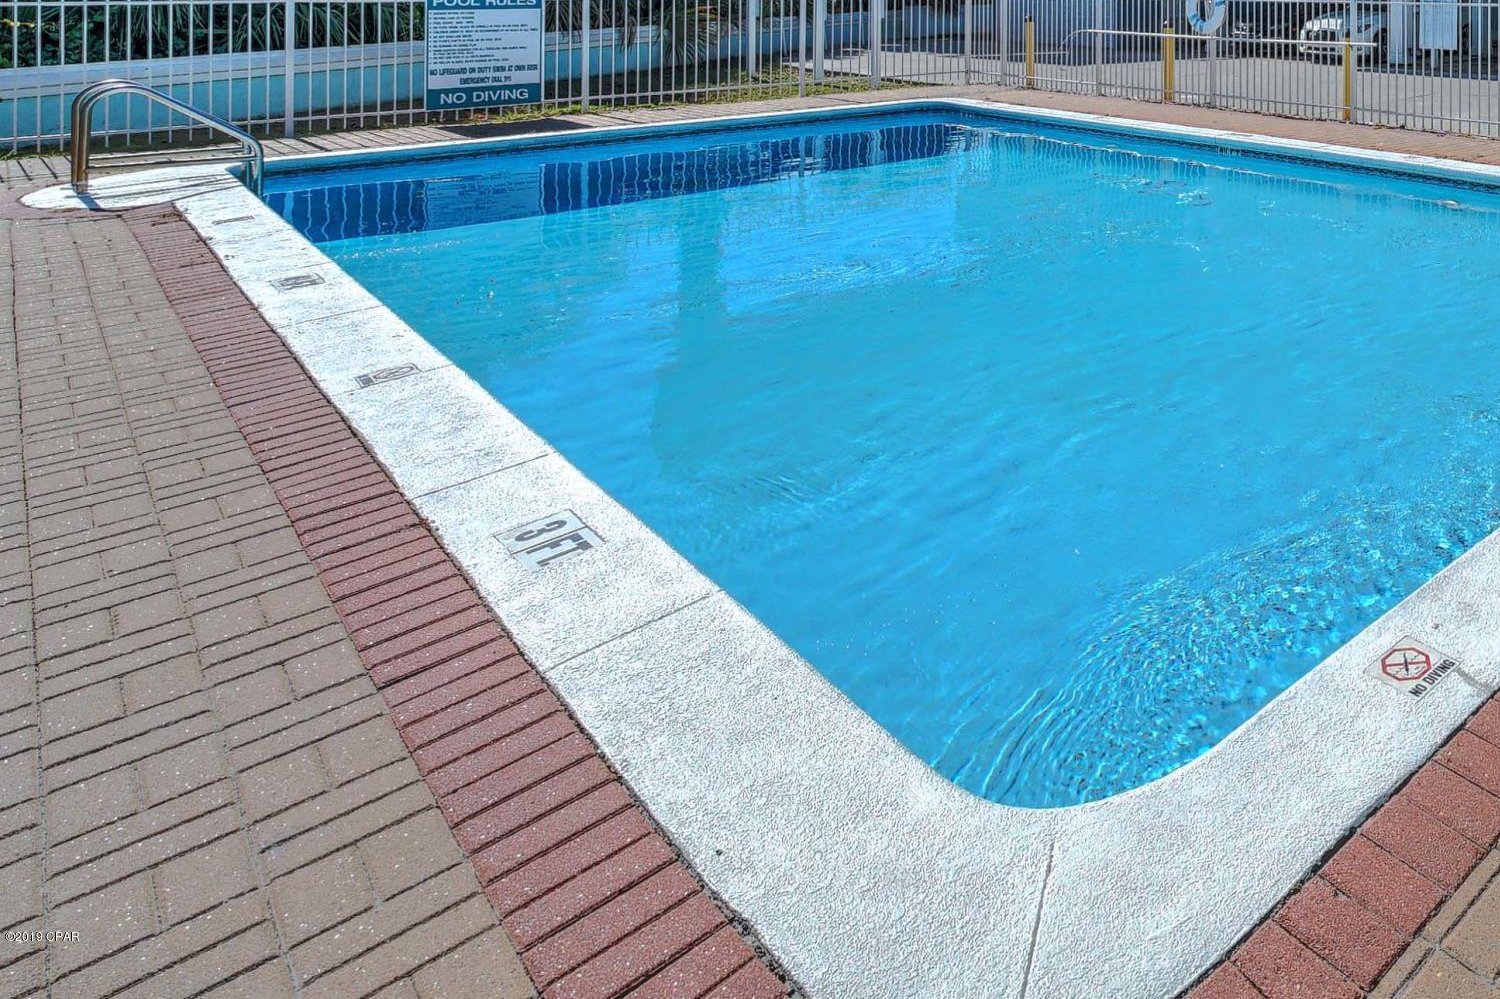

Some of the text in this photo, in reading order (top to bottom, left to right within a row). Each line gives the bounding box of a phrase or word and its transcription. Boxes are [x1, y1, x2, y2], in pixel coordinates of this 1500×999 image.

[477, 66, 491, 74] DUTY
[459, 77, 490, 85] EMERGENCY
[440, 88, 529, 105] NO DIVING
[1408, 659, 1456, 698] NO DIVING
